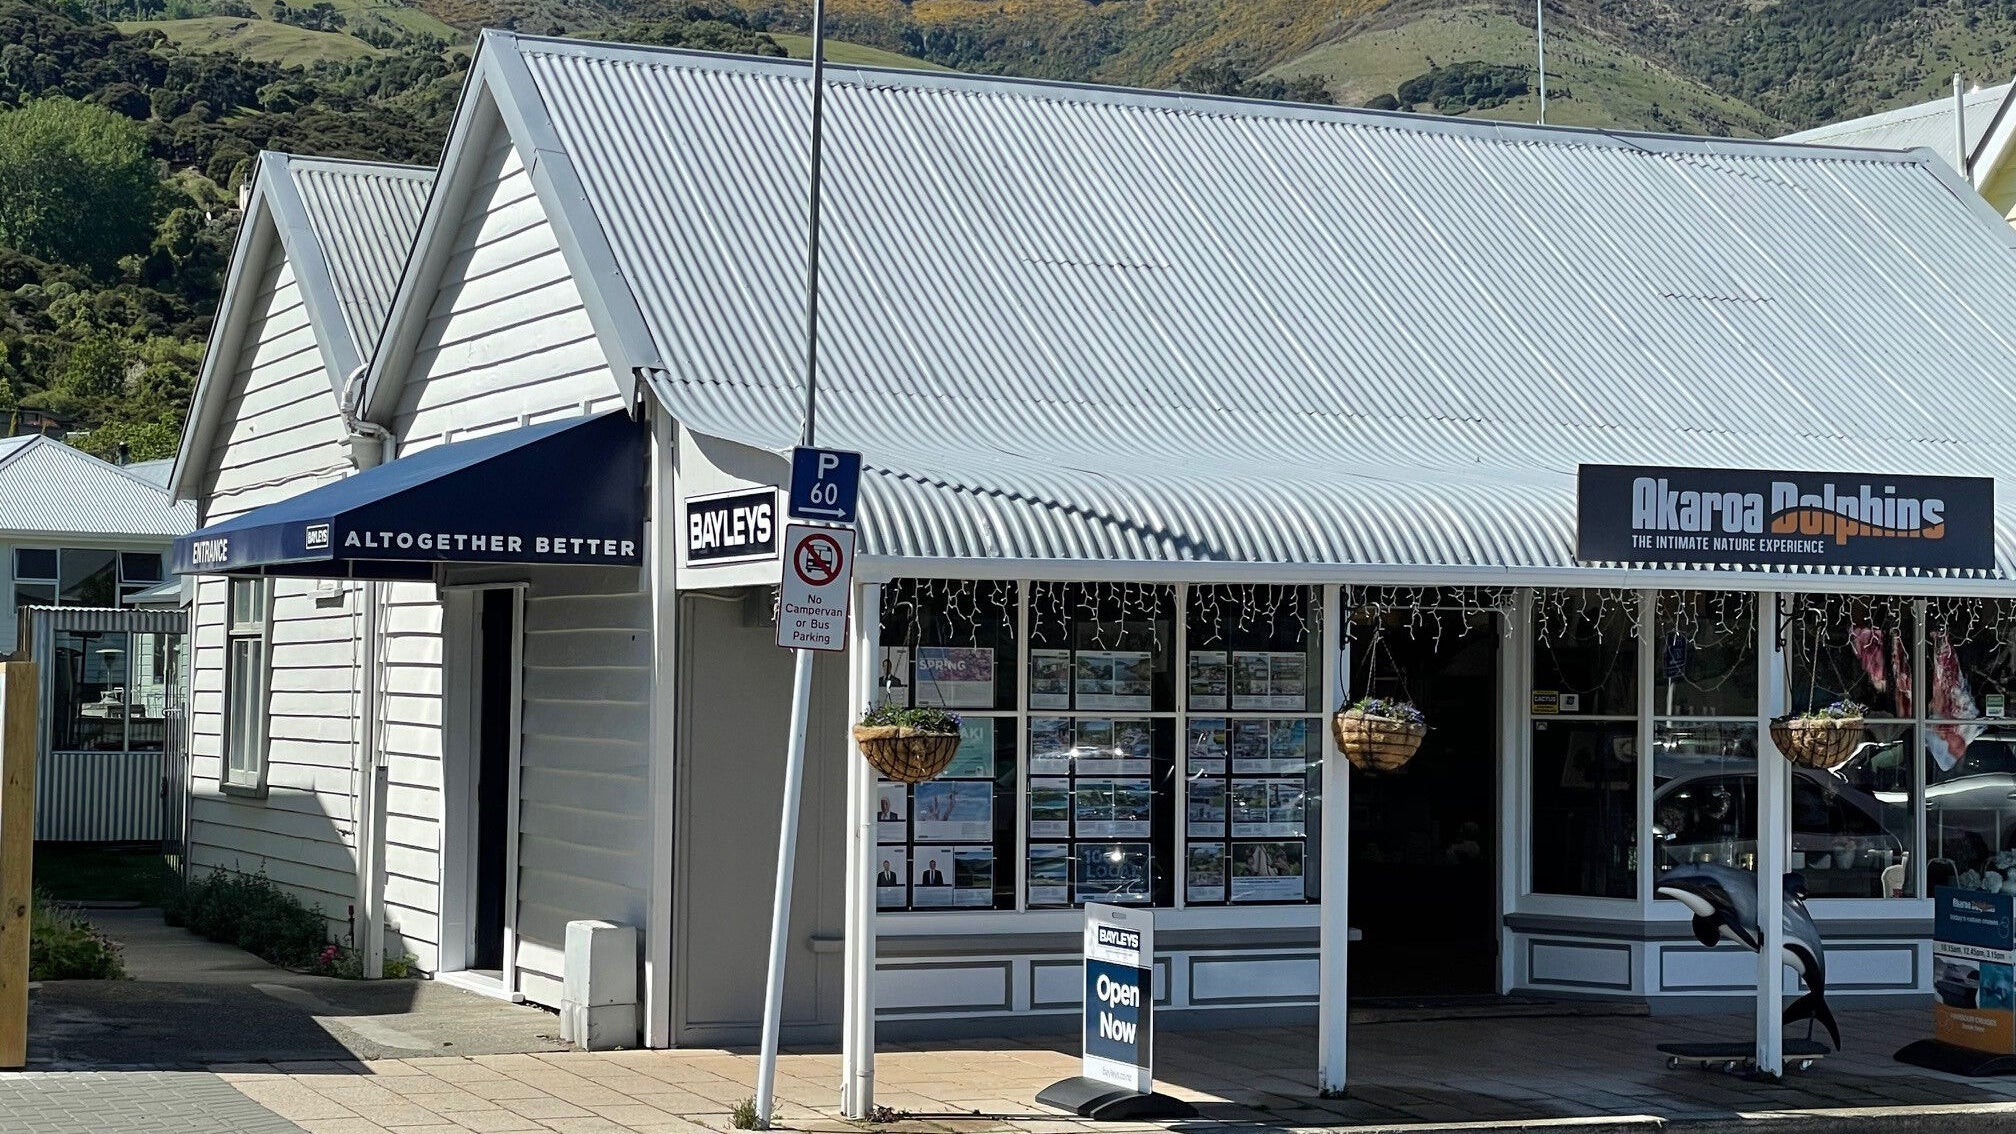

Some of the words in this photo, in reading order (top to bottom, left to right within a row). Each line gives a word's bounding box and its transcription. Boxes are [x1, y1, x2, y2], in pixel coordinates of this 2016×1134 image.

[817, 453, 839, 479] P
[810, 483, 838, 505] 60
[1632, 477, 1764, 533] Akaroa
[1771, 481, 1945, 545] Dolphins
[690, 504, 771, 549] BAYLEYS
[192, 538, 228, 564] ENTRANCE
[345, 531, 522, 552] ALTOGETHER
[535, 537, 635, 557] BETTER
[1631, 534, 1652, 548] THE
[1656, 536, 1709, 550] INTIMATE
[1713, 537, 1755, 551] NATURE
[1759, 539, 1825, 553] EXPERIENCE
[785, 603, 843, 617] Campervan
[807, 594, 822, 604] No
[796, 620, 806, 628] or
[811, 619, 830, 629] Bus
[793, 631, 831, 645] Parking
[919, 660, 966, 670] SPRING
[1099, 928, 1139, 948] BAYLEYS
[1096, 973, 1140, 1008] Open
[1100, 1011, 1137, 1045] Now
